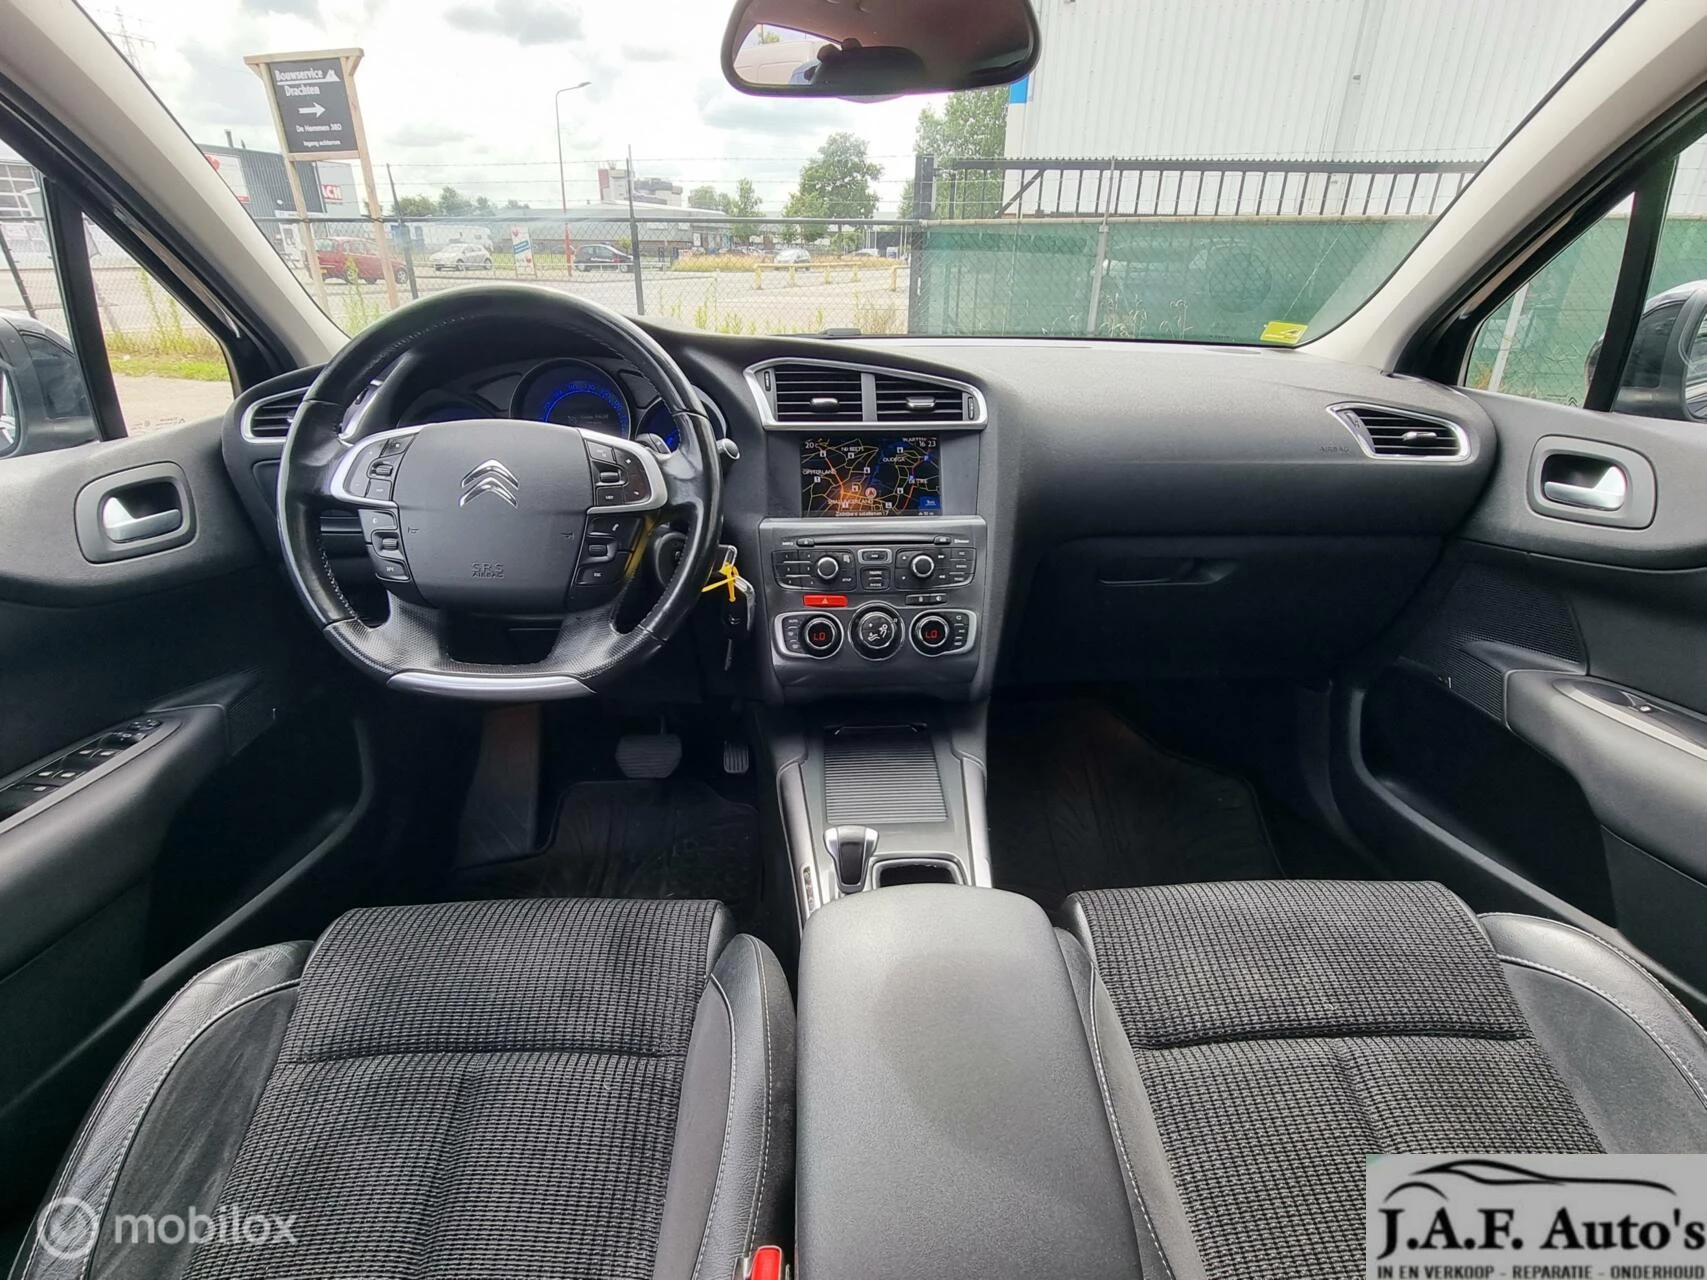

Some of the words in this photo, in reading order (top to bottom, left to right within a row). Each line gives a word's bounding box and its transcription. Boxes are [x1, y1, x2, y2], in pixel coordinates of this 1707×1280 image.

[274, 68, 323, 81] Bouwservice
[284, 84, 320, 97] Drachten
[472, 562, 504, 571] SRS
